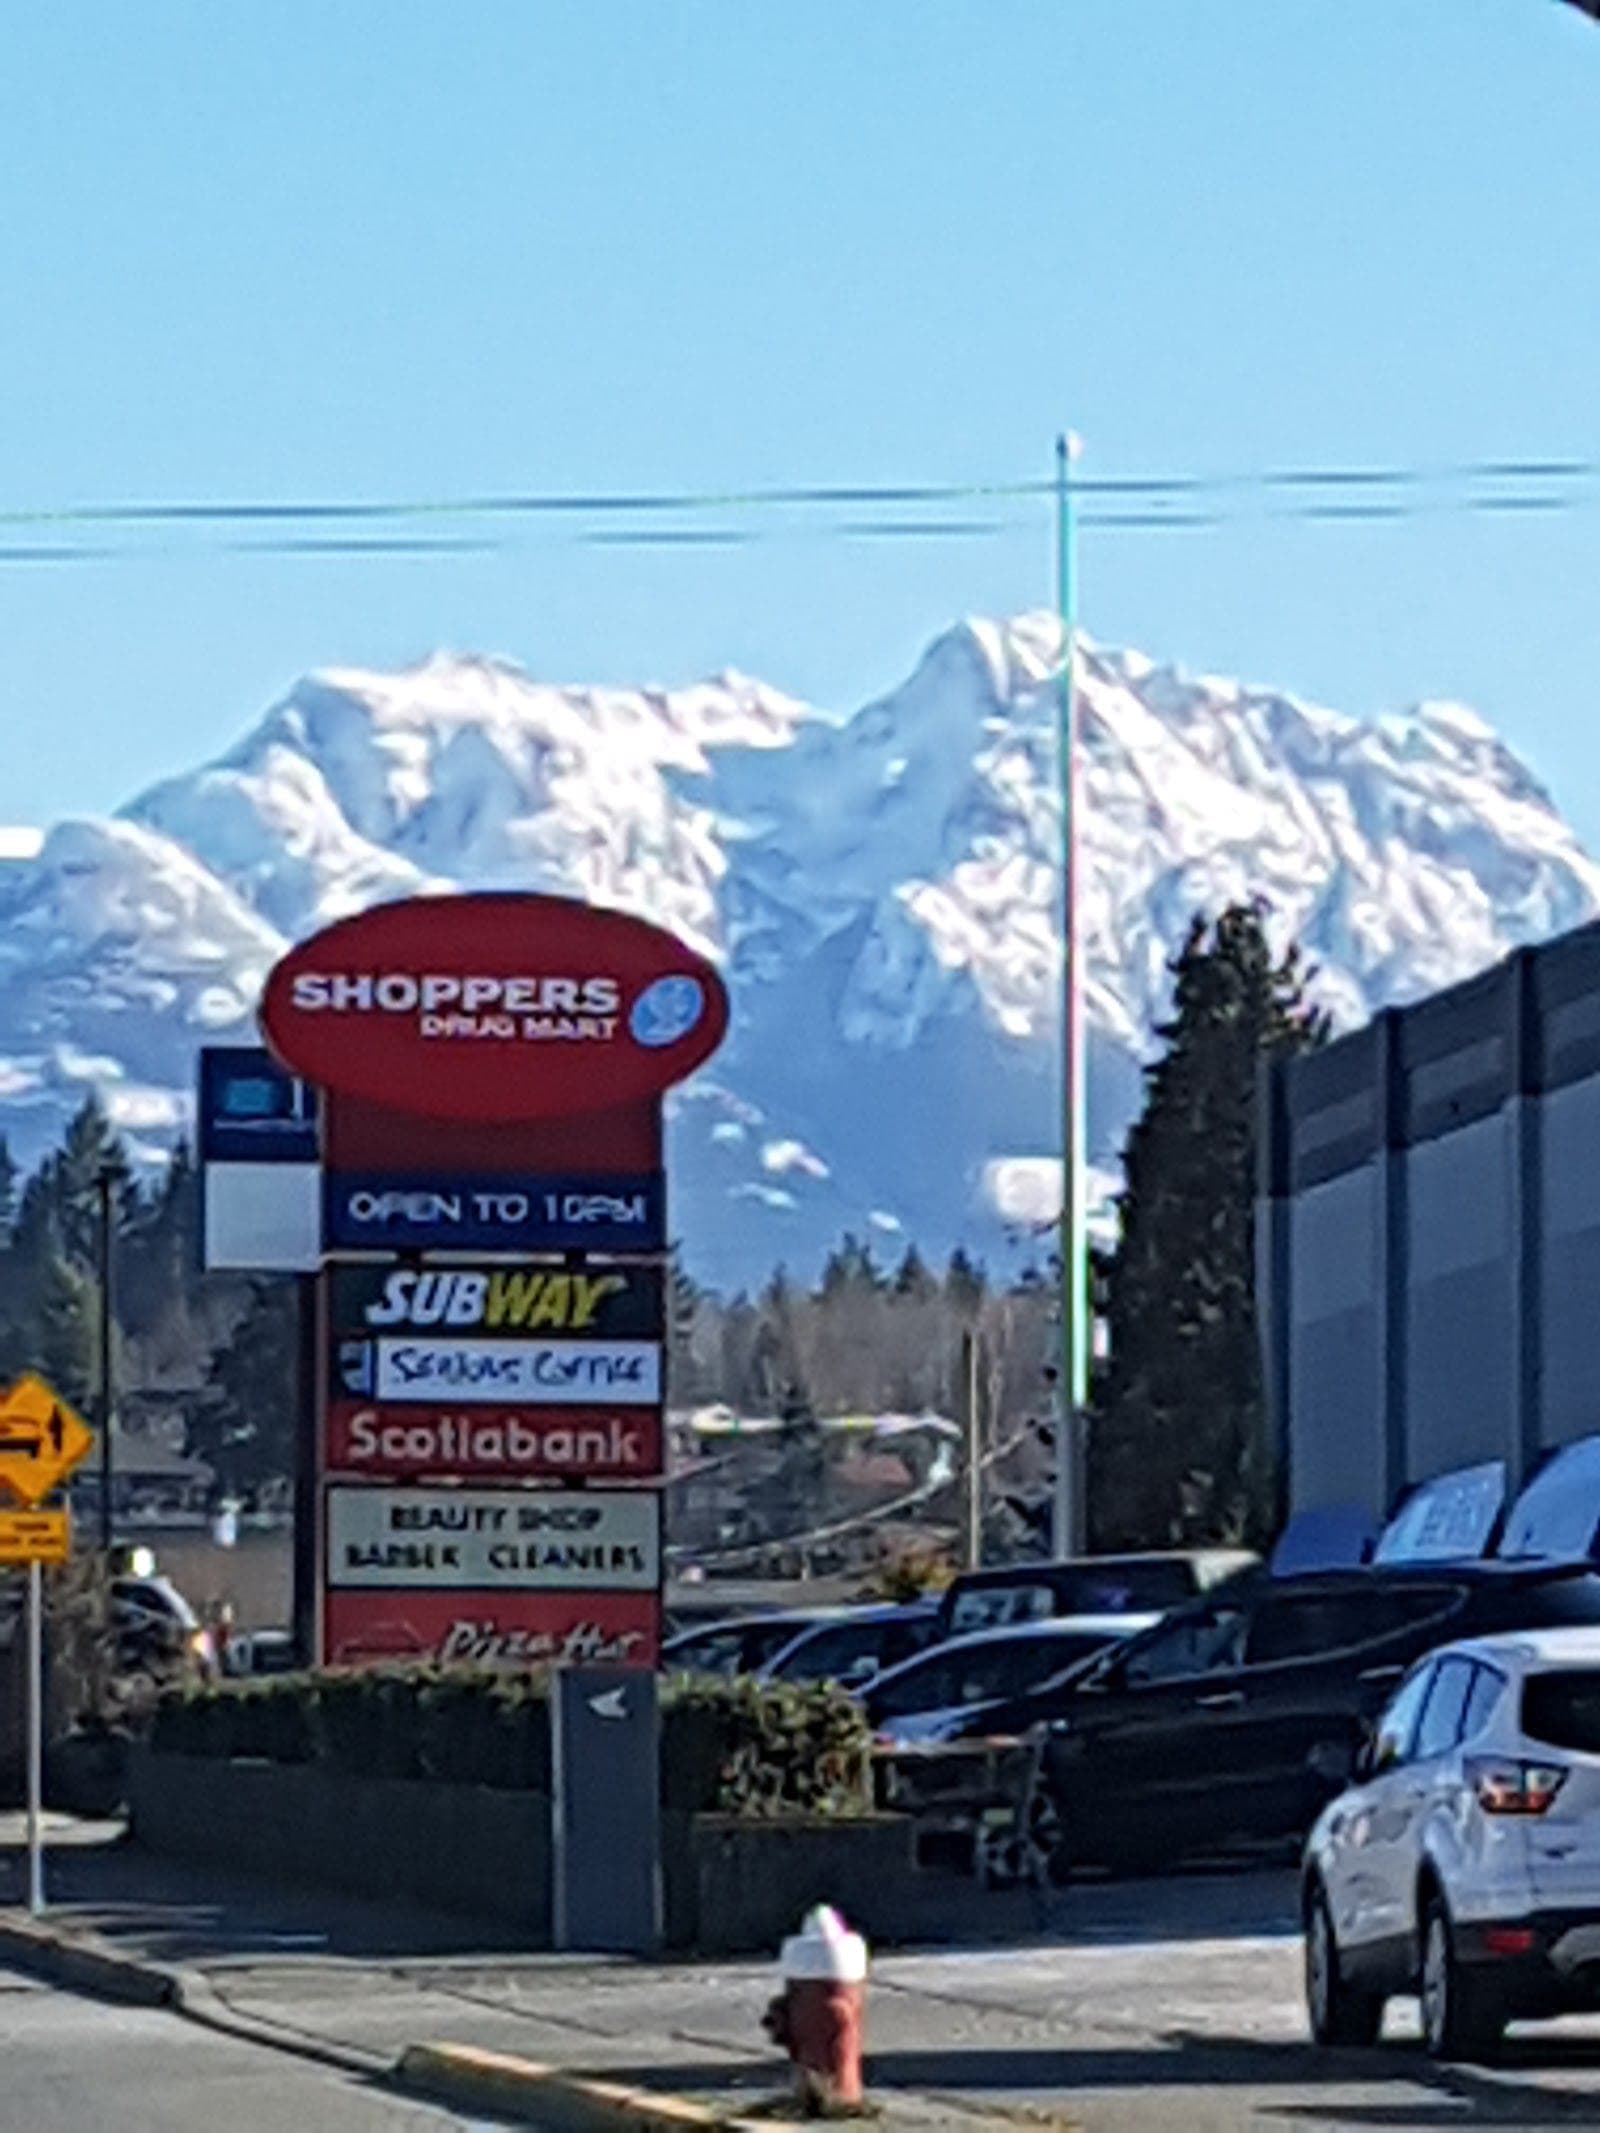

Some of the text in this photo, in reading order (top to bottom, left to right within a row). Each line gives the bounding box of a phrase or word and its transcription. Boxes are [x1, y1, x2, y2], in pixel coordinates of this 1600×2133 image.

[292, 974, 619, 1013] SHOPPERS
[420, 1015, 618, 1040] DRUG MART
[348, 1191, 462, 1221] OPEN
[472, 1194, 528, 1222] TO
[365, 1270, 627, 1328] SUBWAY
[348, 1411, 641, 1463] Scotiabank
[390, 1504, 507, 1531] BEAUTY
[487, 1544, 646, 1572] CLEANERS
